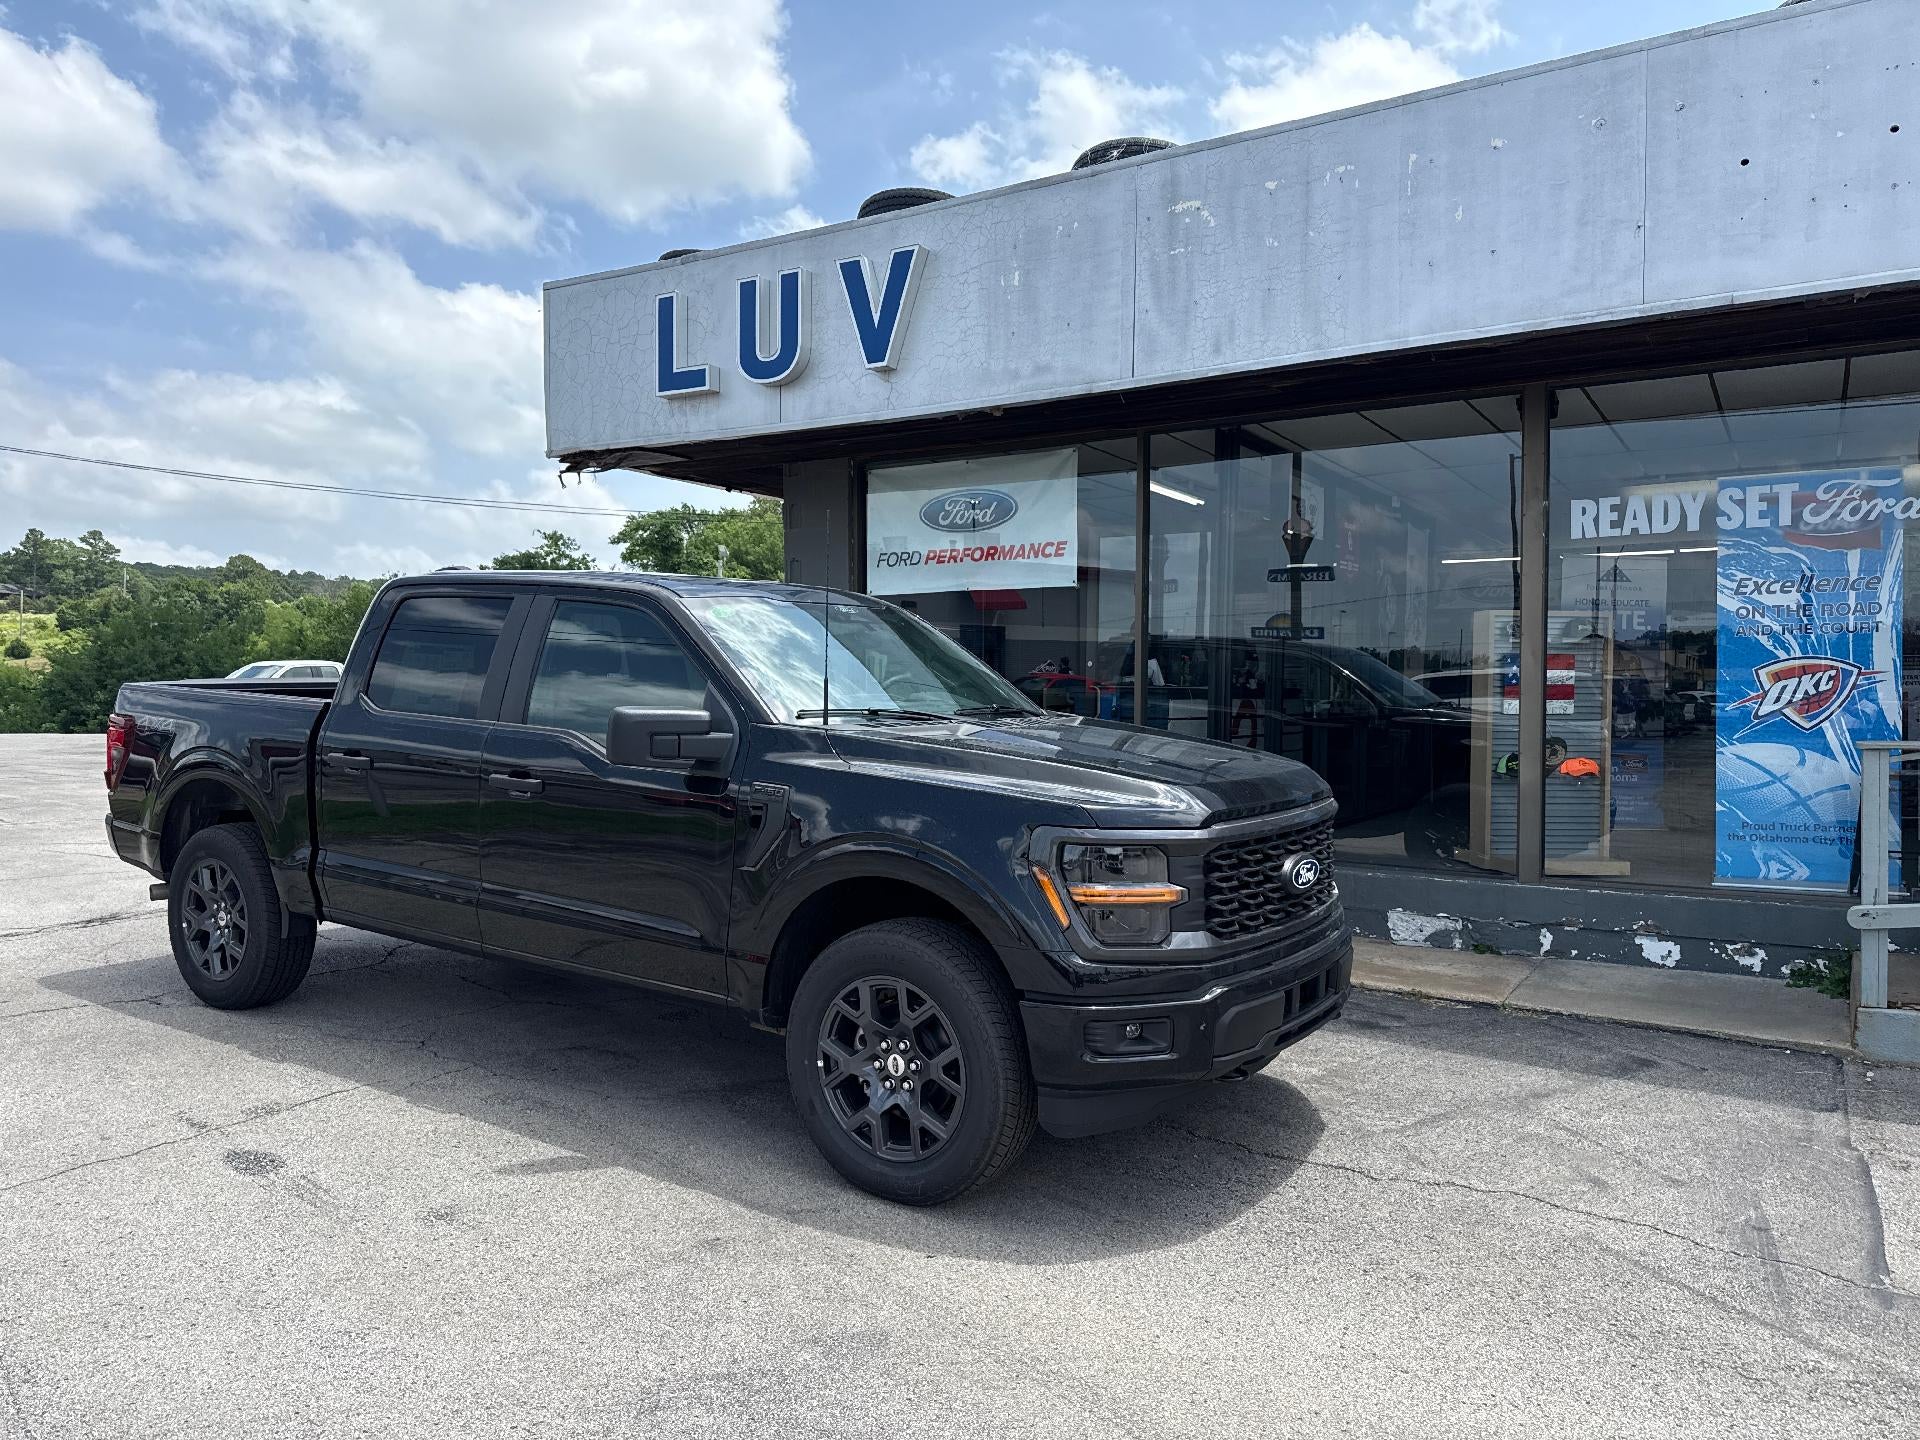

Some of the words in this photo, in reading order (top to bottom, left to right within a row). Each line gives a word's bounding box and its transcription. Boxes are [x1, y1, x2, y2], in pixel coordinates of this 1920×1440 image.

[939, 496, 997, 526] Ford
[1570, 490, 1711, 540] READY
[1715, 482, 1800, 531] SET
[877, 552, 922, 568] FORD
[924, 541, 1068, 565] PERFORMANCE
[1734, 574, 1882, 596] Excellence
[1735, 605, 1766, 619] ON
[1772, 603, 1814, 618] THE
[1821, 601, 1882, 617] ROAD
[1735, 623, 1773, 637] AND
[1779, 622, 1814, 635] THE
[1820, 620, 1882, 634] COURT
[1755, 668, 1839, 717] OKC
[1741, 821, 1775, 831] Proud
[1779, 822, 1811, 832] Truck
[1813, 824, 1857, 834] Partner
[1728, 834, 1746, 842] the
[1750, 833, 1809, 845] Oklahoma
[1812, 835, 1835, 846] City
[1297, 862, 1317, 886] Ford
